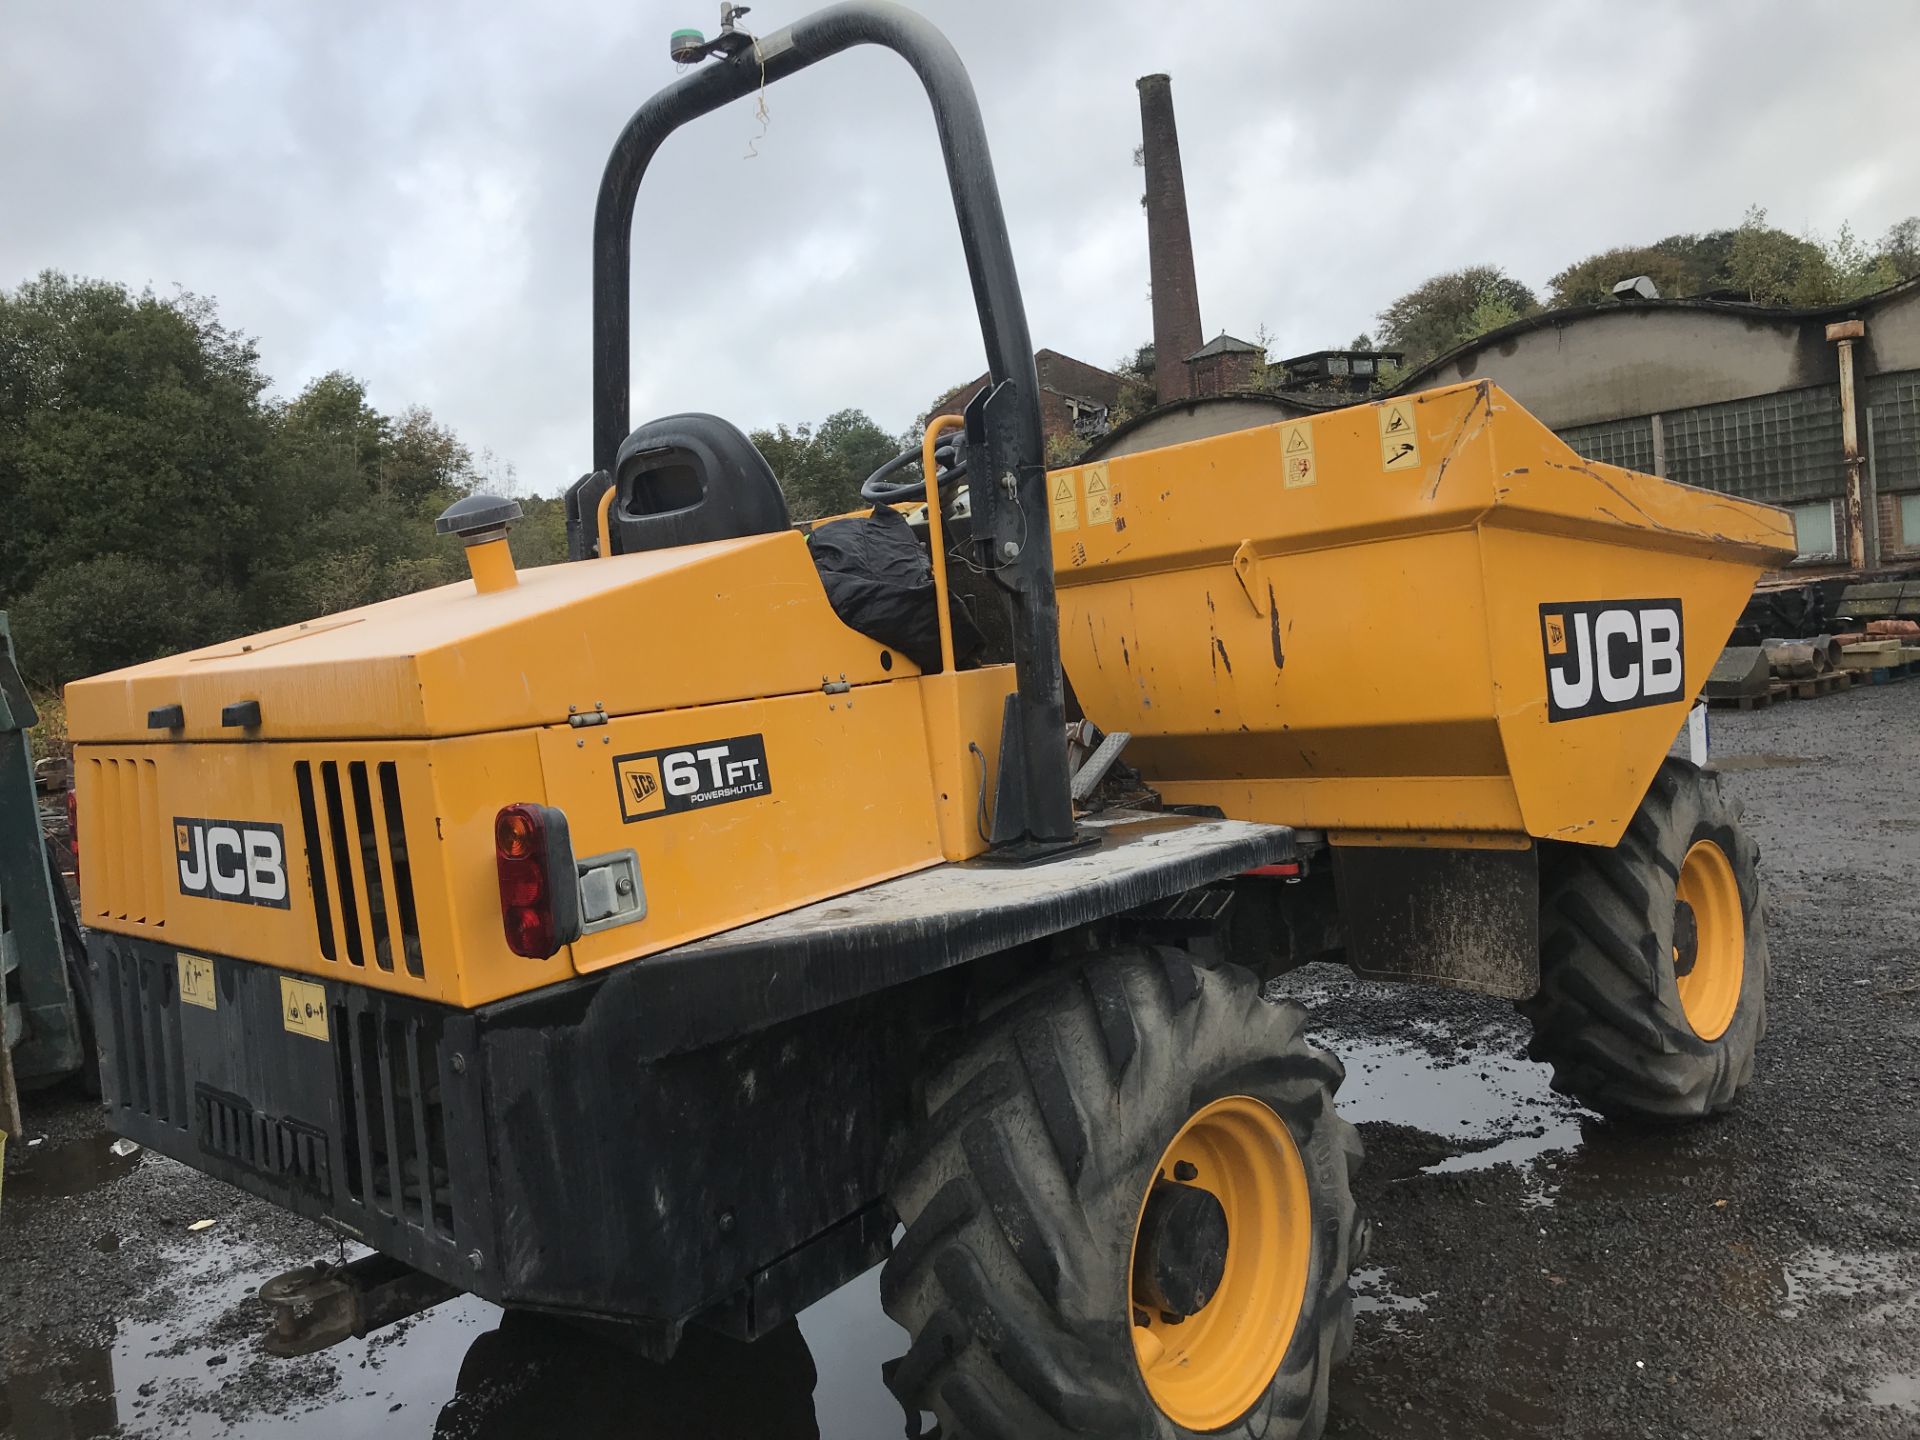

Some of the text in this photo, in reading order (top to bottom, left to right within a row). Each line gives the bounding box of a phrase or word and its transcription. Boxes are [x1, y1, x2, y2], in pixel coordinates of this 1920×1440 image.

[1550, 608, 1682, 709] JCB
[631, 774, 657, 799] JCB
[690, 782, 763, 804] POWERSHUTTLE
[179, 826, 286, 900] JCB
